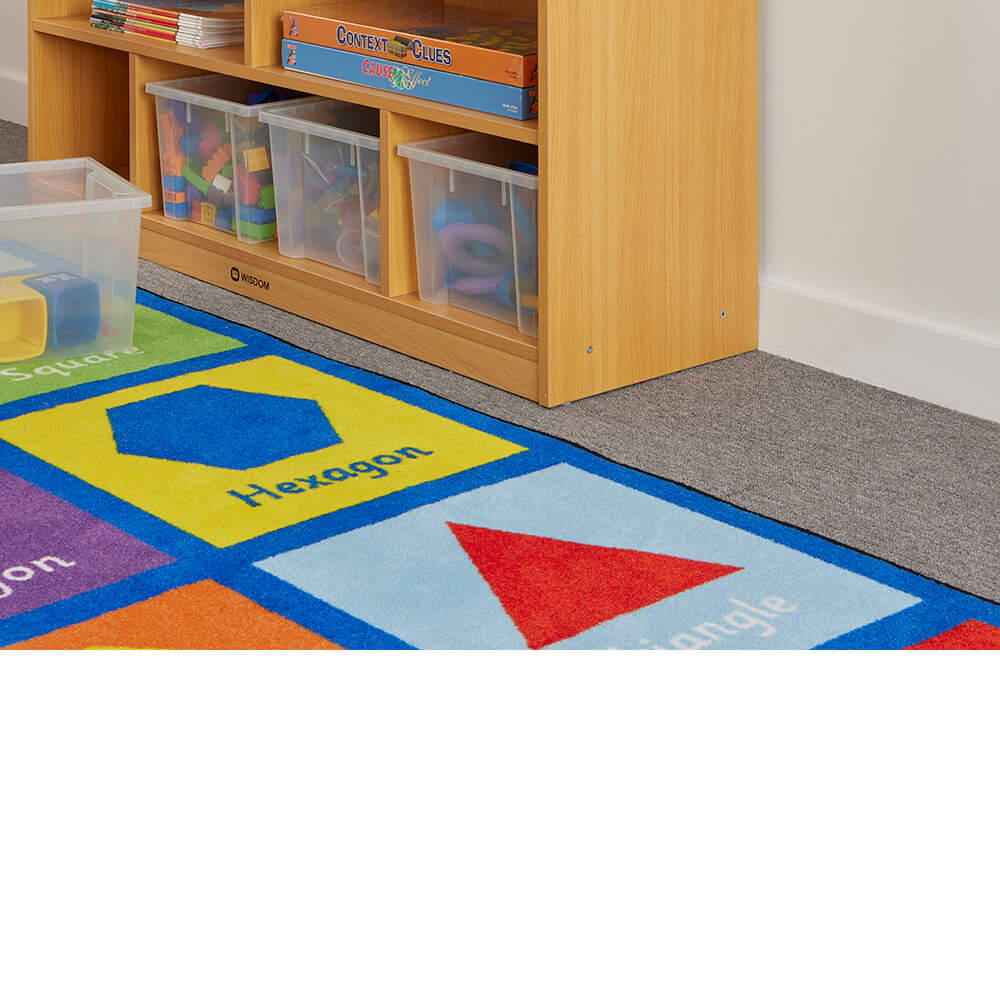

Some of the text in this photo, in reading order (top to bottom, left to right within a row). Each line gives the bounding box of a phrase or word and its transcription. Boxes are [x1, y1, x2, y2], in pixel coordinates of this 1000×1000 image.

[336, 24, 452, 65] CONTEXT CLUES
[362, 58, 394, 80] CAUSE
[241, 273, 270, 291] WISDOM
[0, 344, 144, 382] Square
[227, 441, 434, 509] Hexagon
